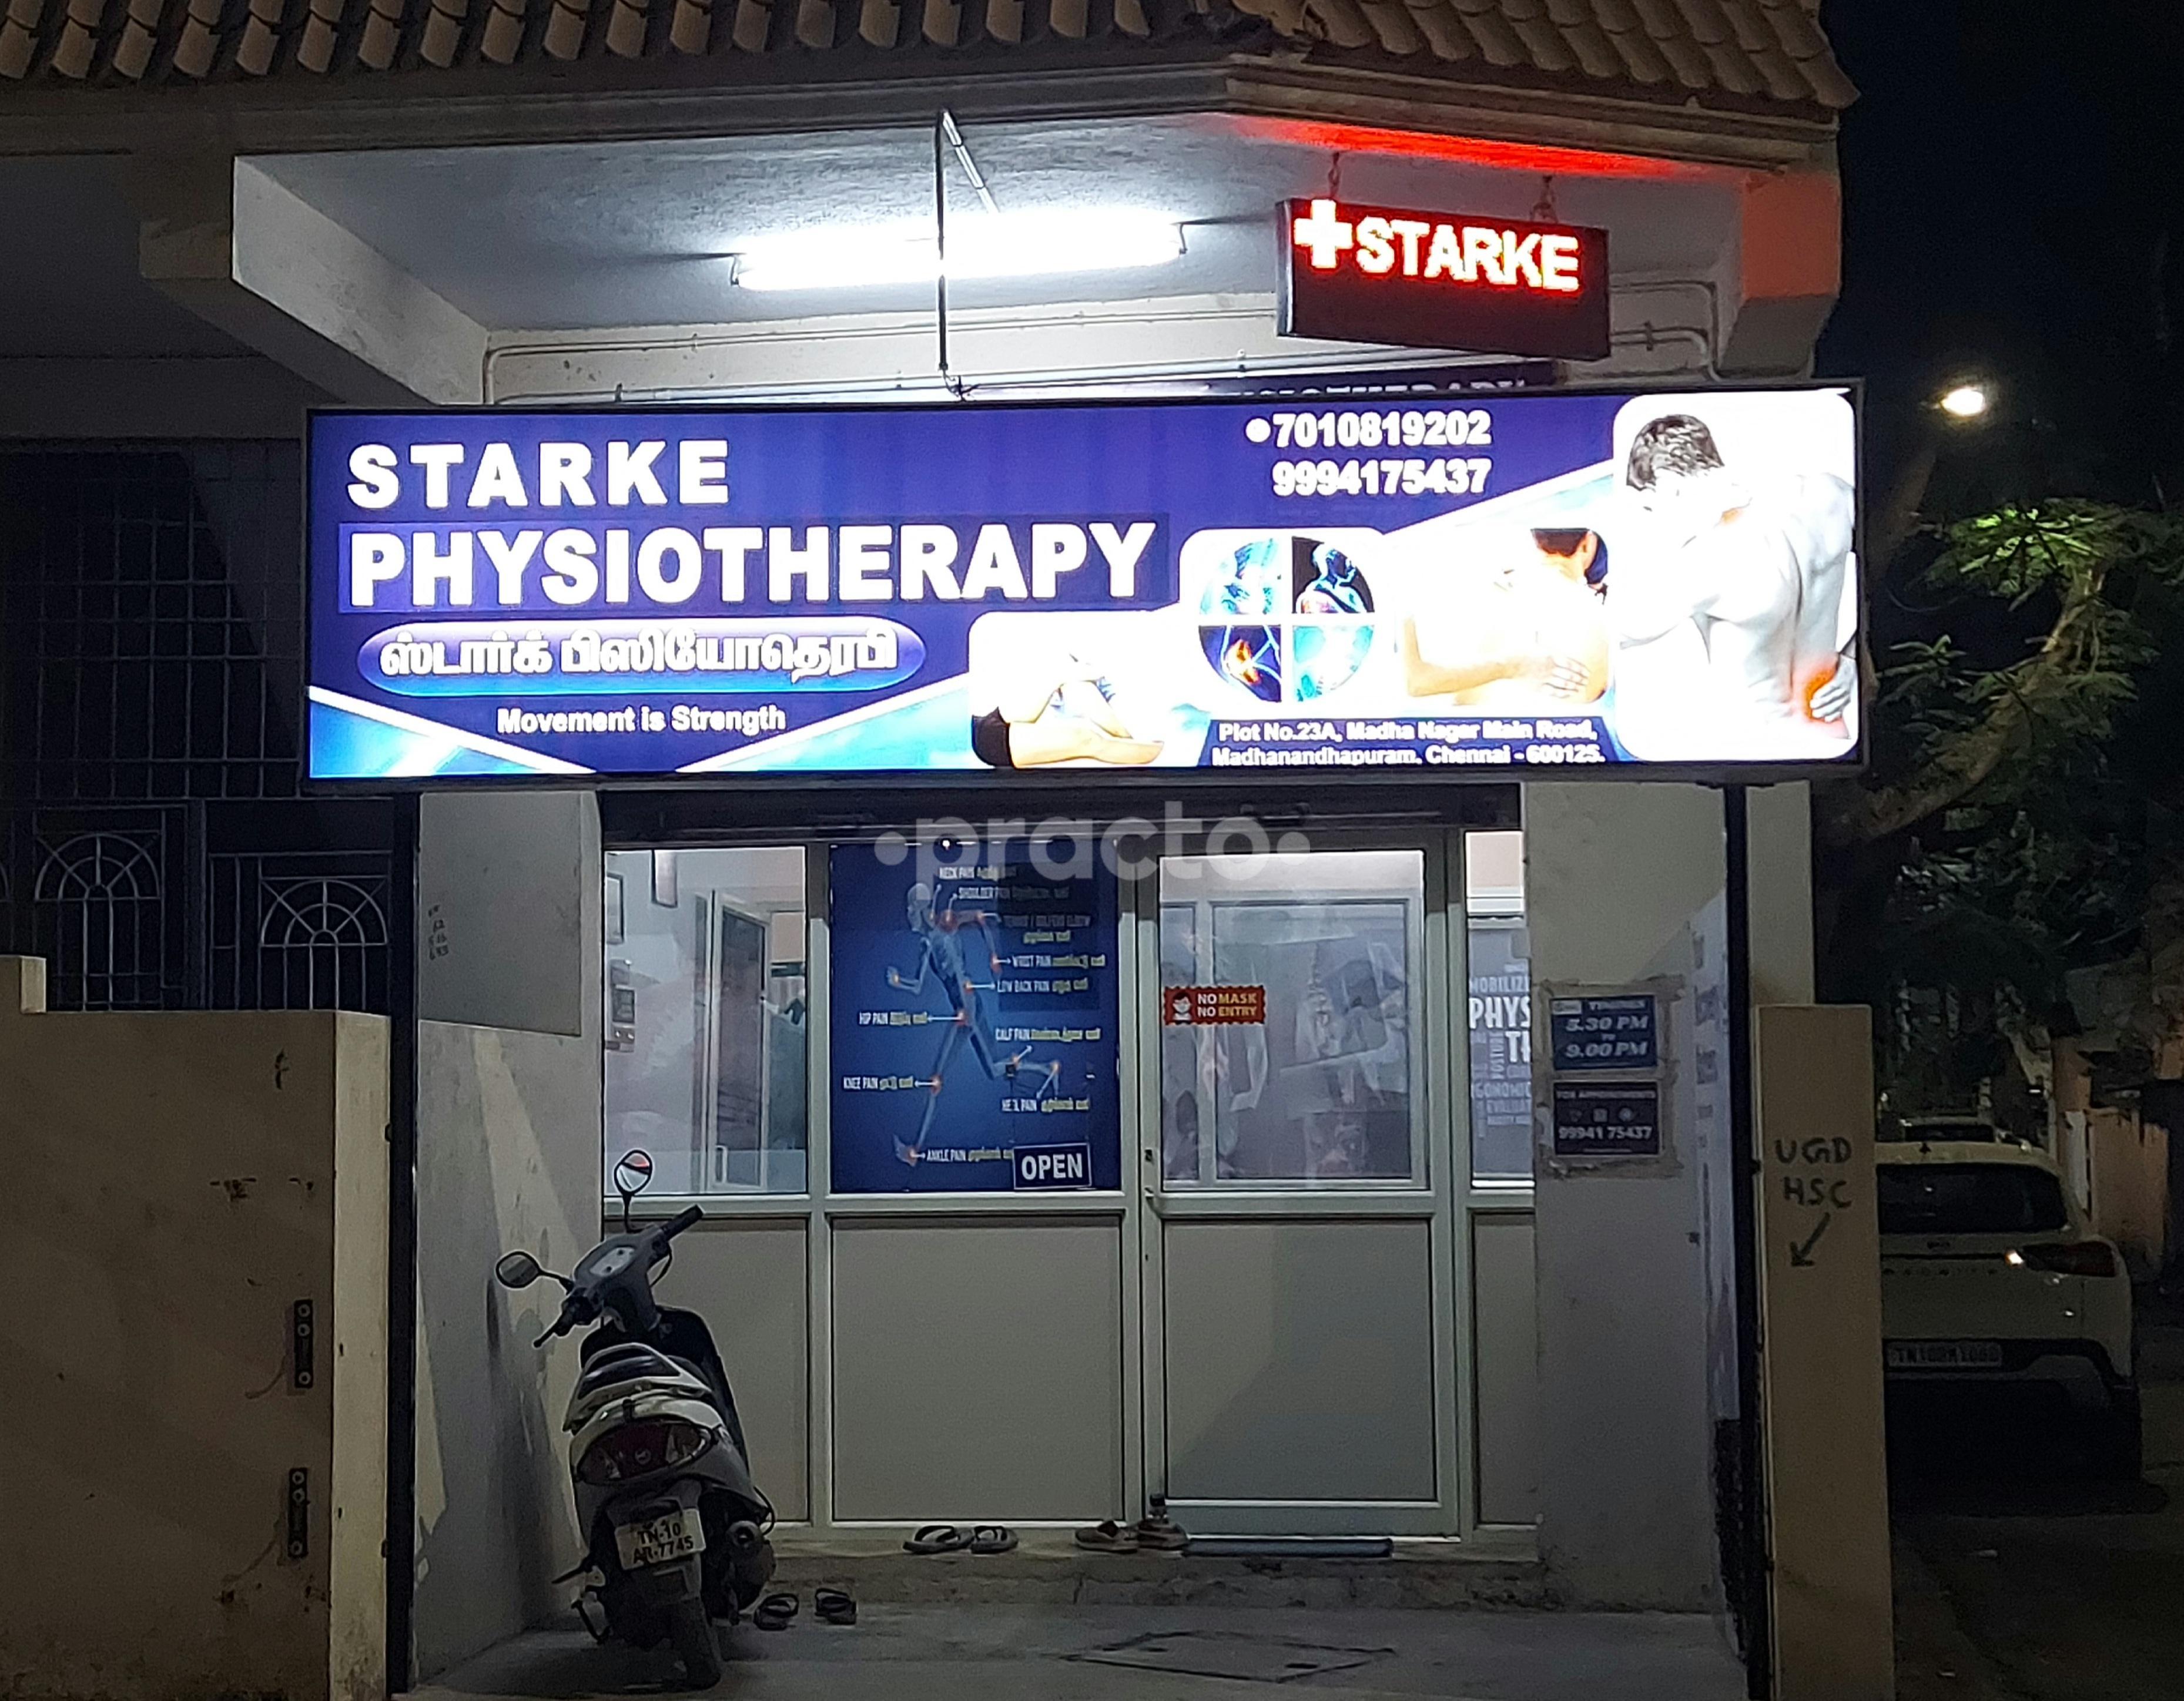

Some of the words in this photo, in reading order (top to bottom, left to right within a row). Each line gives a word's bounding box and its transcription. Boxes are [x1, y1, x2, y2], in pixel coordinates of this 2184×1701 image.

[1355, 215, 1580, 292] STARKE
[1272, 410, 1492, 448] 7010819202
[347, 439, 729, 509] STARKE
[1272, 458, 1492, 495] 9994175437
[351, 522, 1157, 607] PHYSIOTHERAPY
[497, 706, 636, 733] Movement
[640, 706, 666, 732] is
[671, 704, 786, 736] Strength
[1219, 723, 1261, 742] Plot
[1346, 721, 1415, 740] Madha
[1482, 720, 1533, 739] Main
[1536, 719, 1597, 740] Road,
[1425, 744, 1511, 764] Chennai
[1197, 993, 1217, 1004] NO
[1218, 992, 1257, 1004] MASK
[1197, 1006, 1216, 1017] NO
[1218, 1005, 1257, 1017] ENTRY
[1469, 995, 1531, 1029] PHYS
[1565, 1017, 1612, 1032] 5.30
[1616, 1015, 1649, 1030] PM
[1565, 1043, 1612, 1058] 9.00
[1615, 1041, 1648, 1056] PM
[843, 1076, 860, 1089] KNEE
[862, 1076, 879, 1089] PAIN
[1021, 1099, 1037, 1112] PAIN
[950, 1149, 966, 1162] PAIN
[1021, 1153, 1083, 1181] OPEN
[1783, 1176, 1851, 1208] HSC
